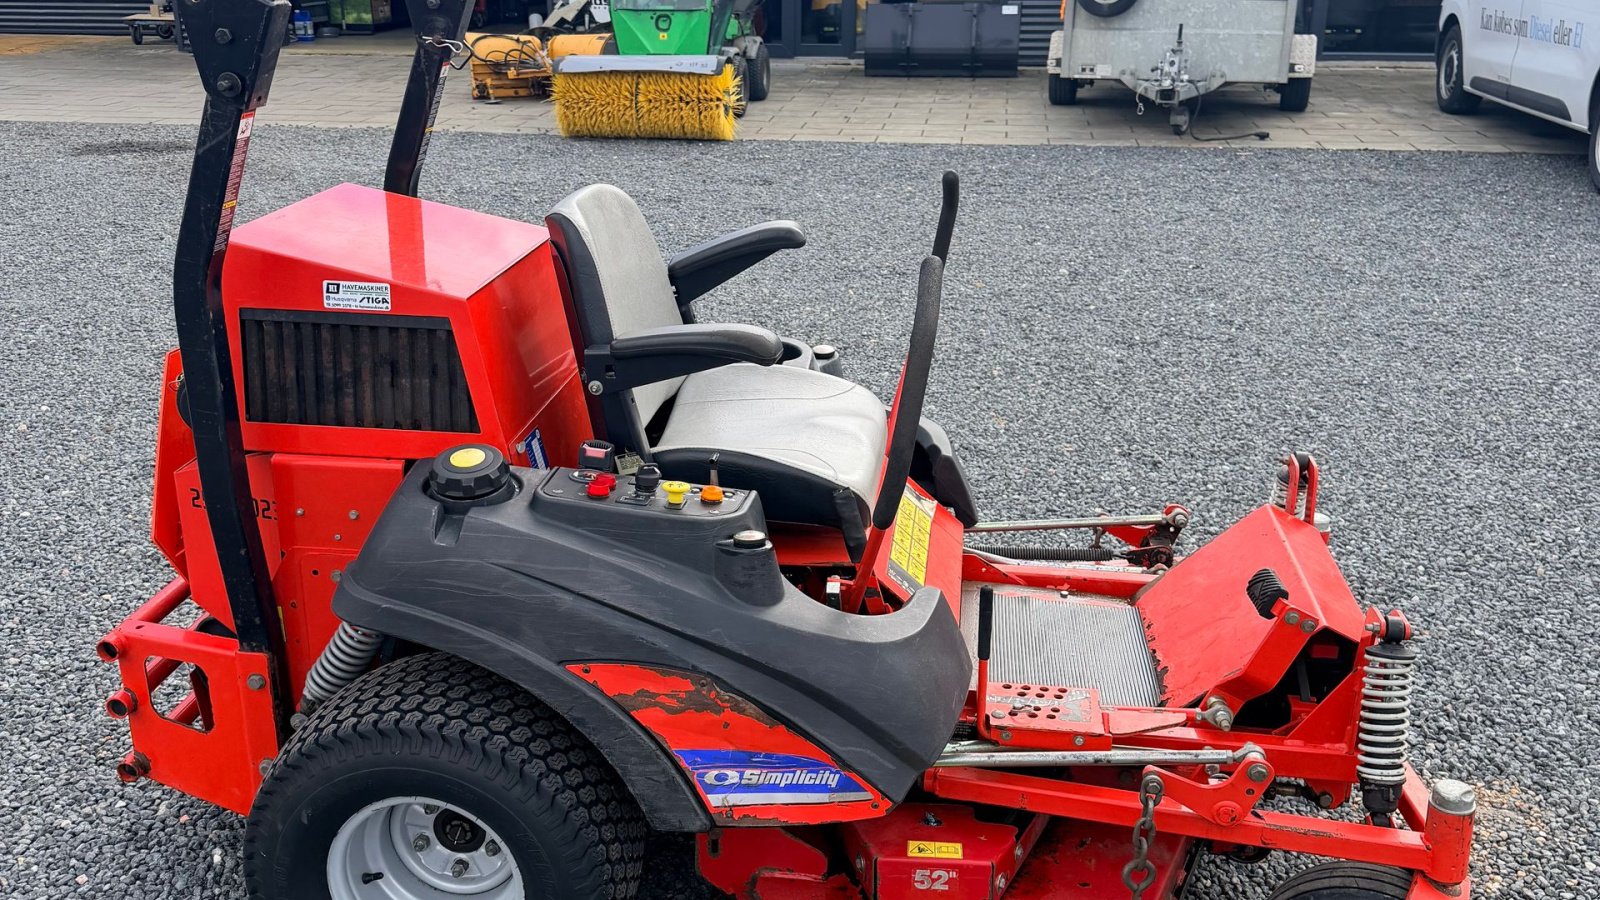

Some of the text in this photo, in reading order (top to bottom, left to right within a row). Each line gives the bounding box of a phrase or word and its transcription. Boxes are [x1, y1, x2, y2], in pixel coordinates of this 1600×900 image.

[1480, 8, 1493, 31] Kan
[1514, 19, 1528, 38] som
[1530, 15, 1553, 42] Diesel
[1553, 19, 1573, 46] eller
[1574, 22, 1584, 48] El
[342, 284, 388, 292] HAVEMASKINER
[740, 769, 841, 788] Simplicity
[913, 869, 957, 891] 52"
